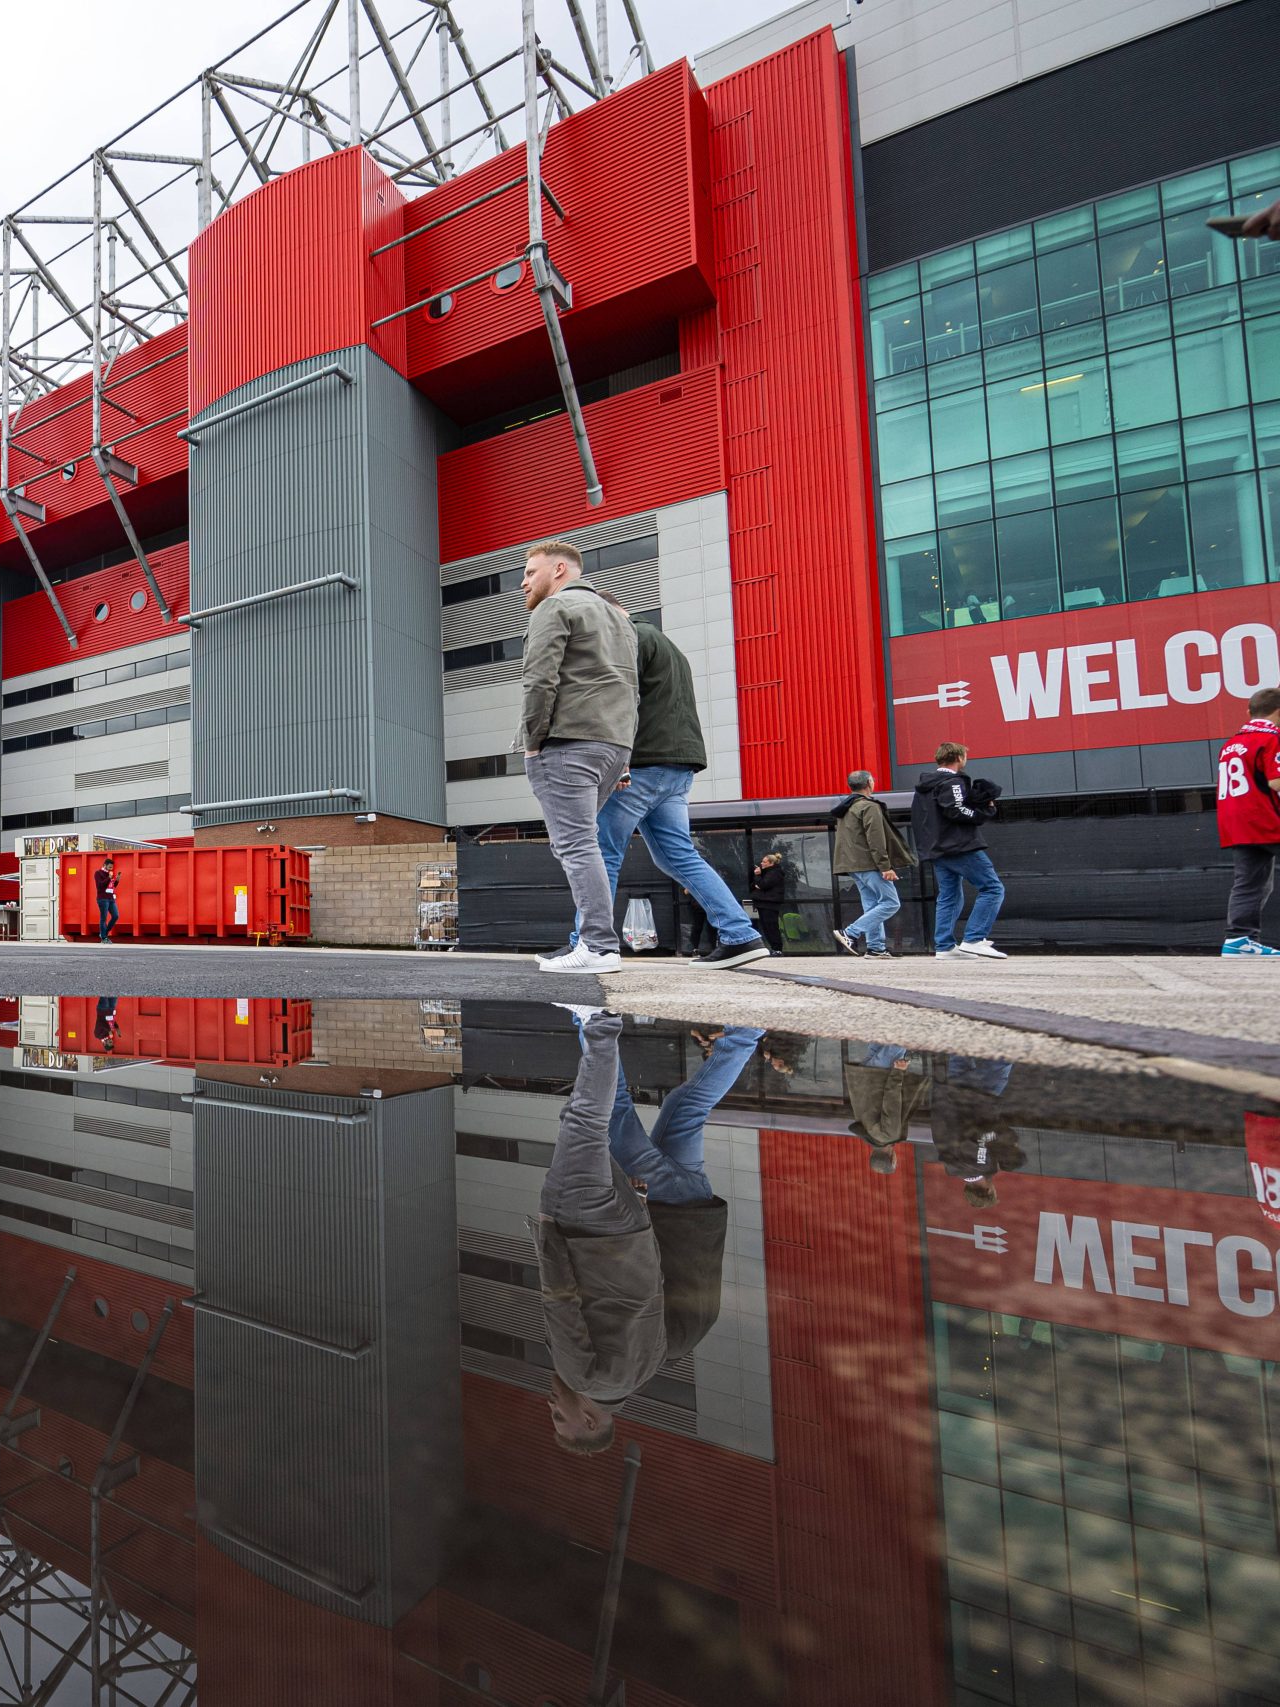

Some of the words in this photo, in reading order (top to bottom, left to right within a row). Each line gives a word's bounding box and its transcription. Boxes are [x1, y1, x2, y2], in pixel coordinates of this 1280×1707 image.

[990, 623, 1280, 722] WELCO
[1218, 757, 1249, 800] 18
[24, 838, 49, 855] HOT
